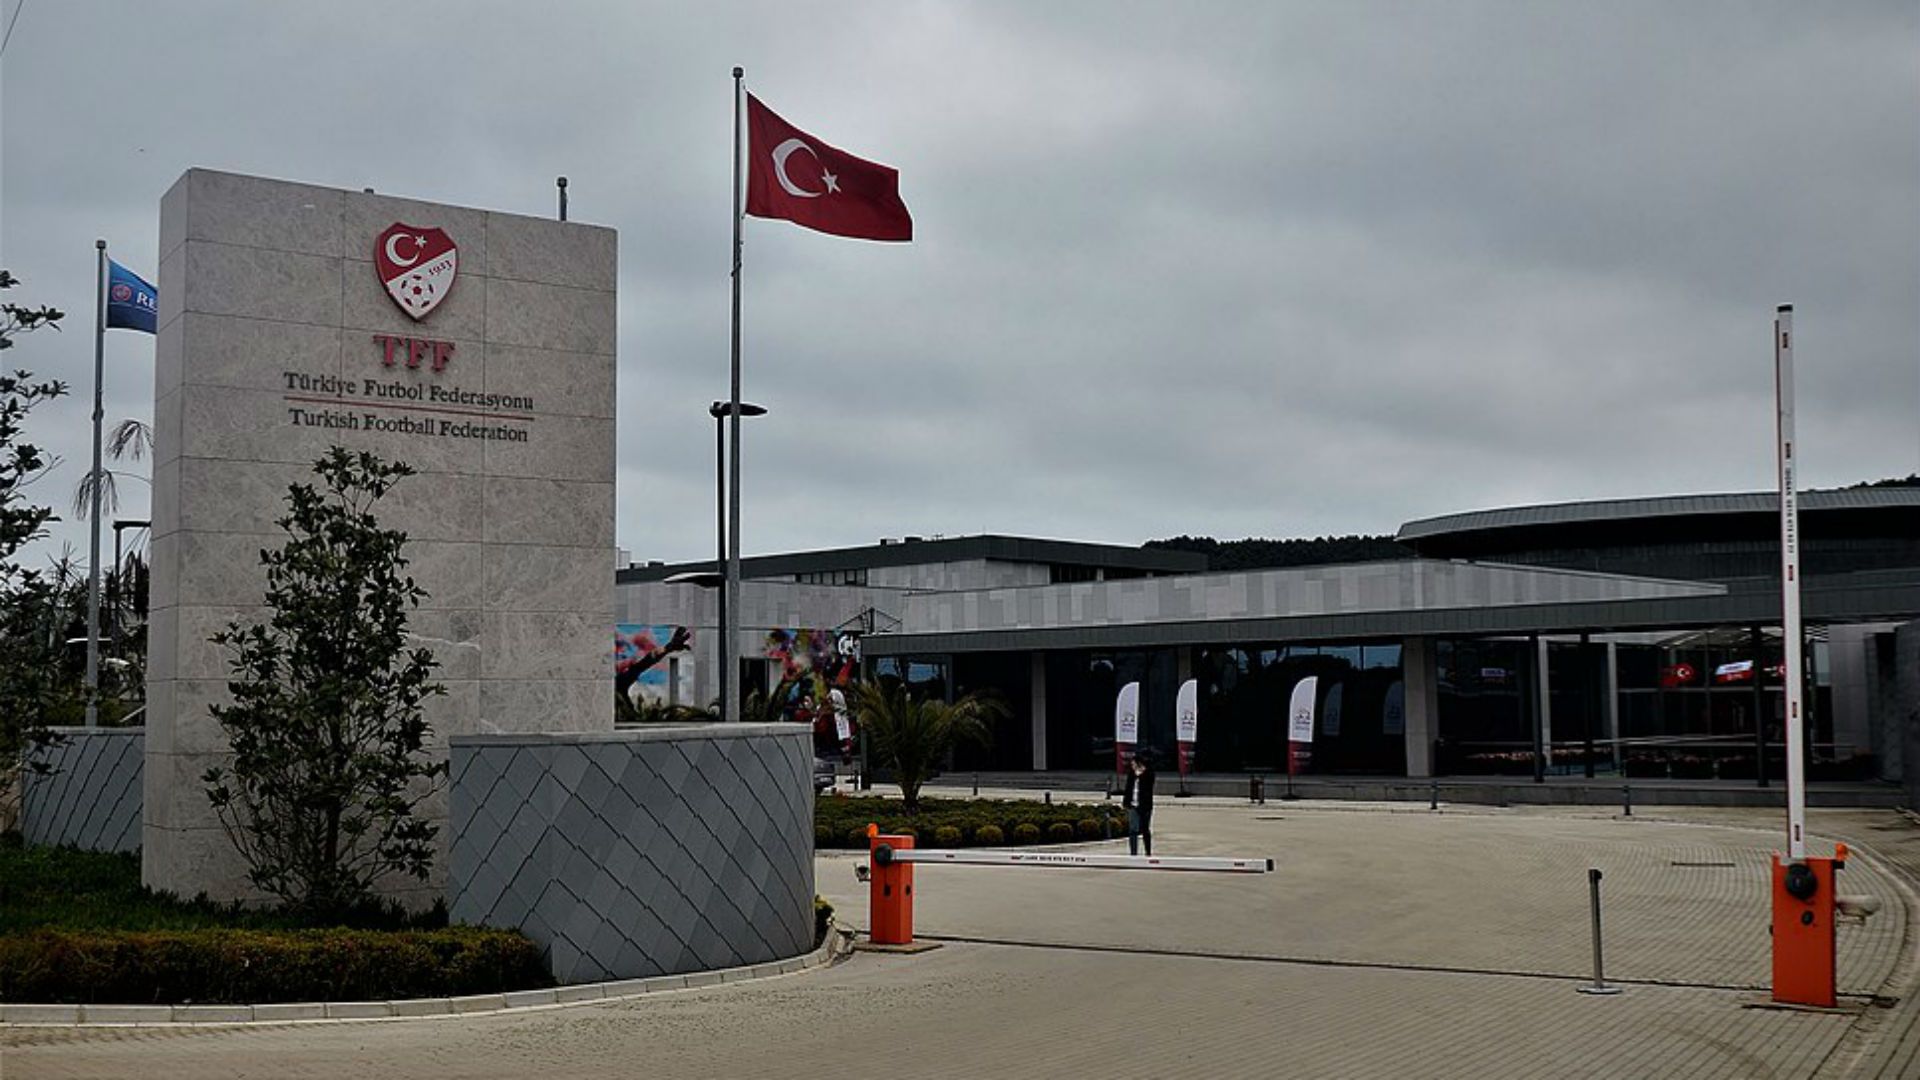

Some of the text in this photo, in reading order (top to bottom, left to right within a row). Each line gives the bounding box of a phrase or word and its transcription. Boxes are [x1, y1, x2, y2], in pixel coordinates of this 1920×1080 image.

[373, 334, 455, 372] TFF
[283, 372, 534, 411] Türkiye Futbol Federasyonu
[288, 408, 528, 442] Turkish Football Federation
